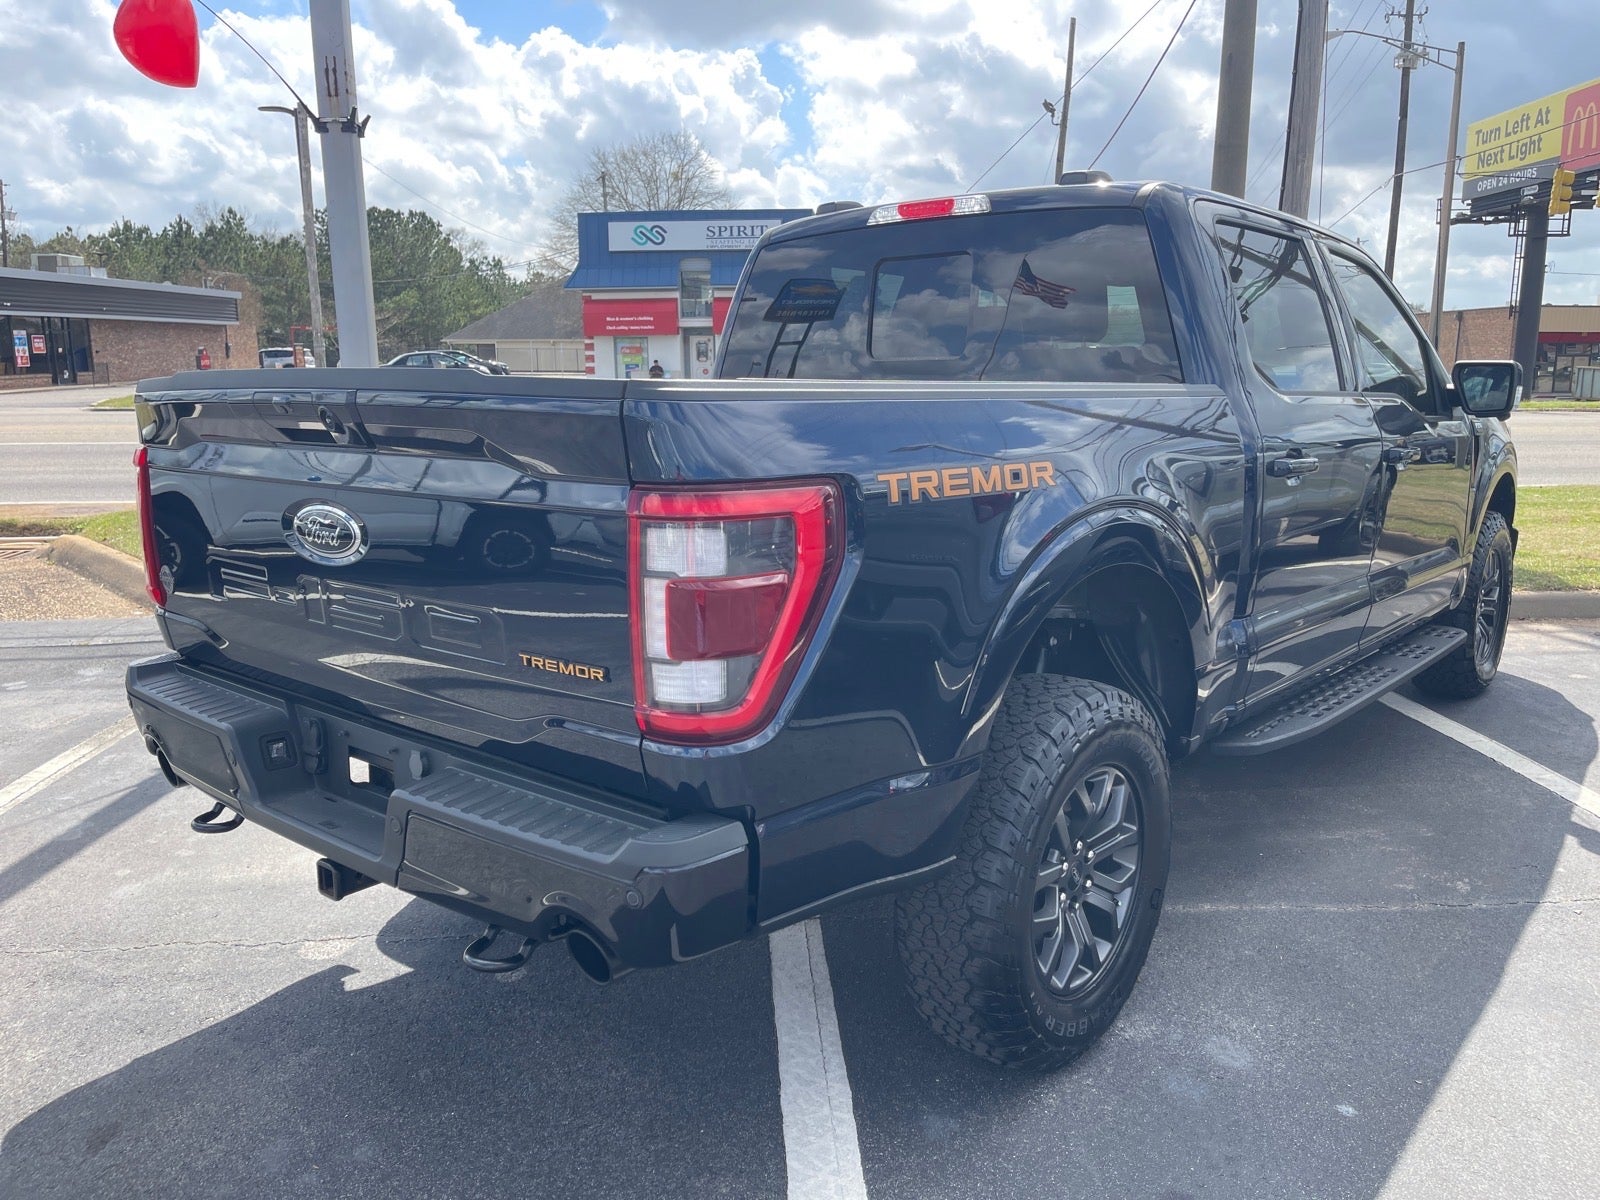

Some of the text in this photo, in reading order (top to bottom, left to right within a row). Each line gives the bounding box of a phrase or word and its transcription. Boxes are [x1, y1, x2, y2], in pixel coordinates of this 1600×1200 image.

[1475, 106, 1551, 147] Turn Left At
[1477, 135, 1543, 170] Next Light
[1477, 168, 1537, 192] OPEN 24 HOURS
[706, 225, 768, 238] SPIRIT
[875, 459, 1057, 505] TREMOR
[304, 515, 342, 547] Ford
[518, 652, 604, 682] TREMOR
